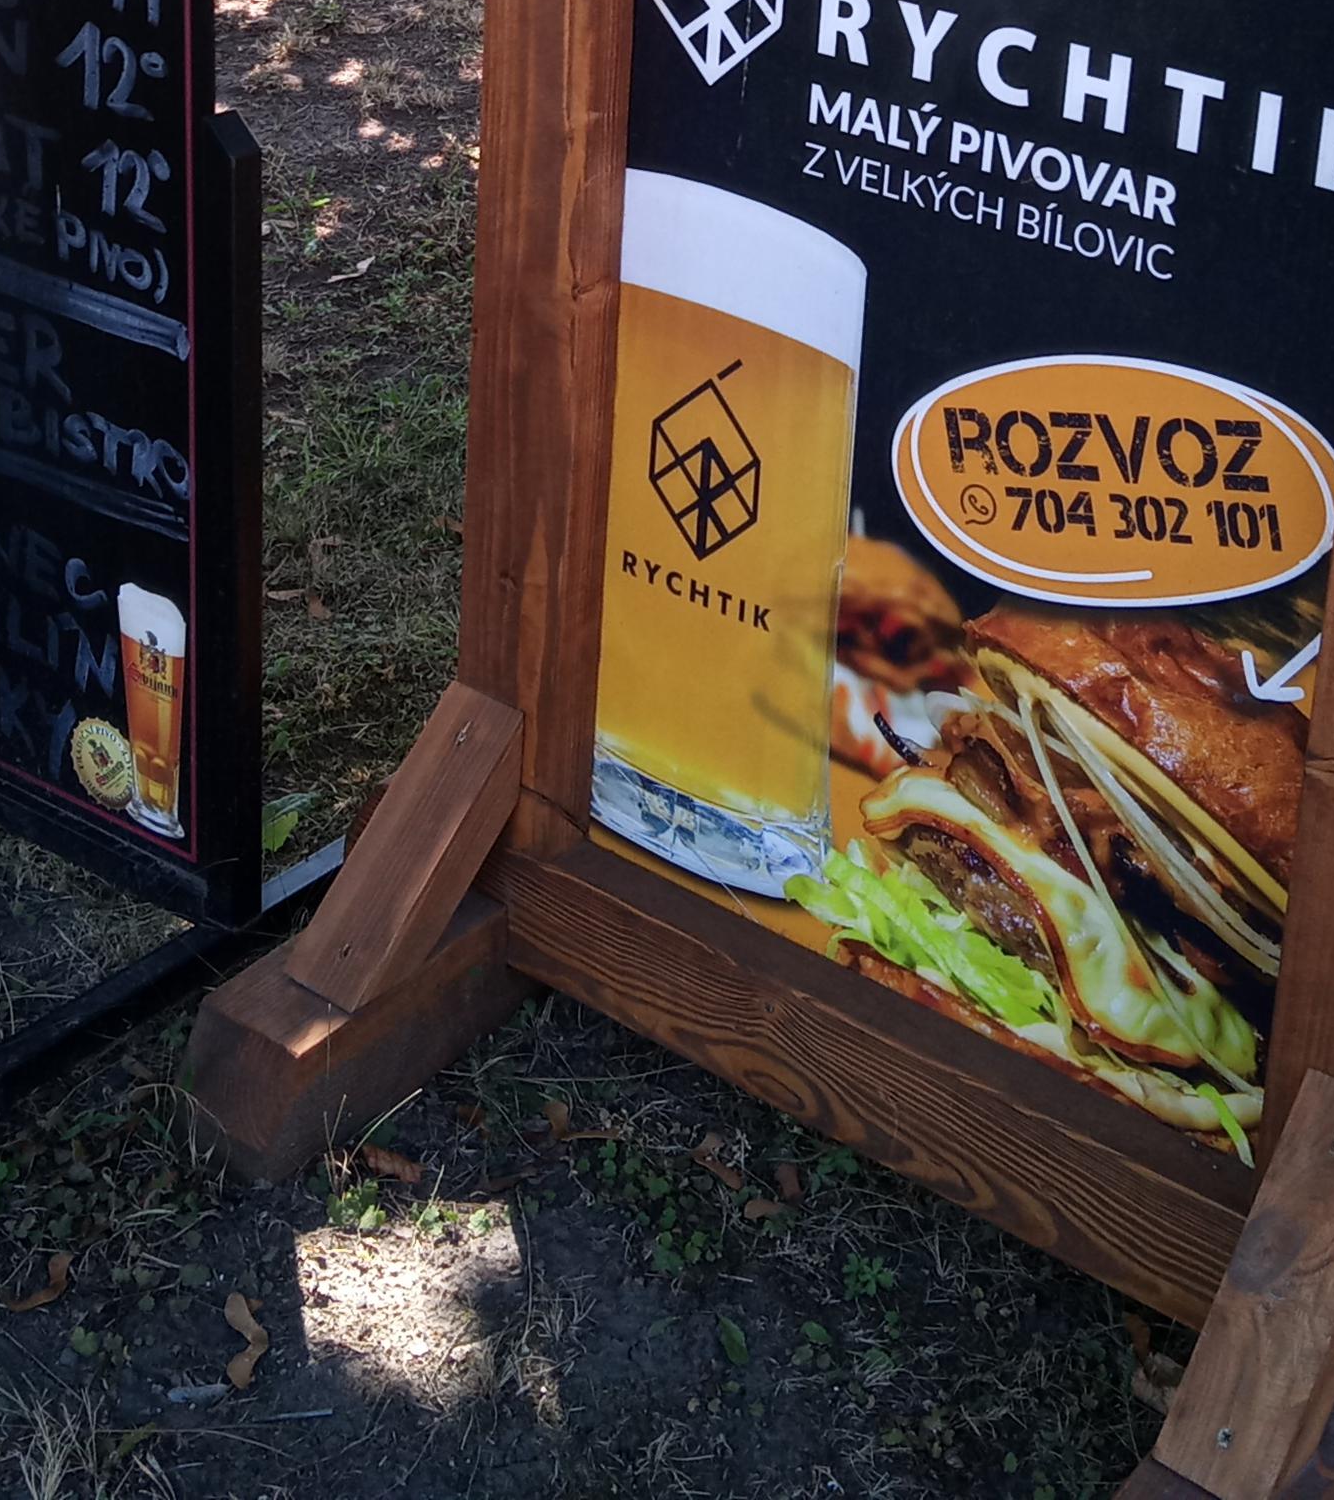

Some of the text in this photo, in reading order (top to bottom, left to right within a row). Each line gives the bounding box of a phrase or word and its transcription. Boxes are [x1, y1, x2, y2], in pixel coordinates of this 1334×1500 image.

[808, 82, 1177, 227] MALÝ PIVOVAR
[802, 141, 1176, 280] Z VELKÝCH BÍLOVIC
[943, 407, 1271, 492] ROZVOZ
[1004, 487, 1284, 553] 704 302 101
[622, 550, 772, 632] RYCHTIK
